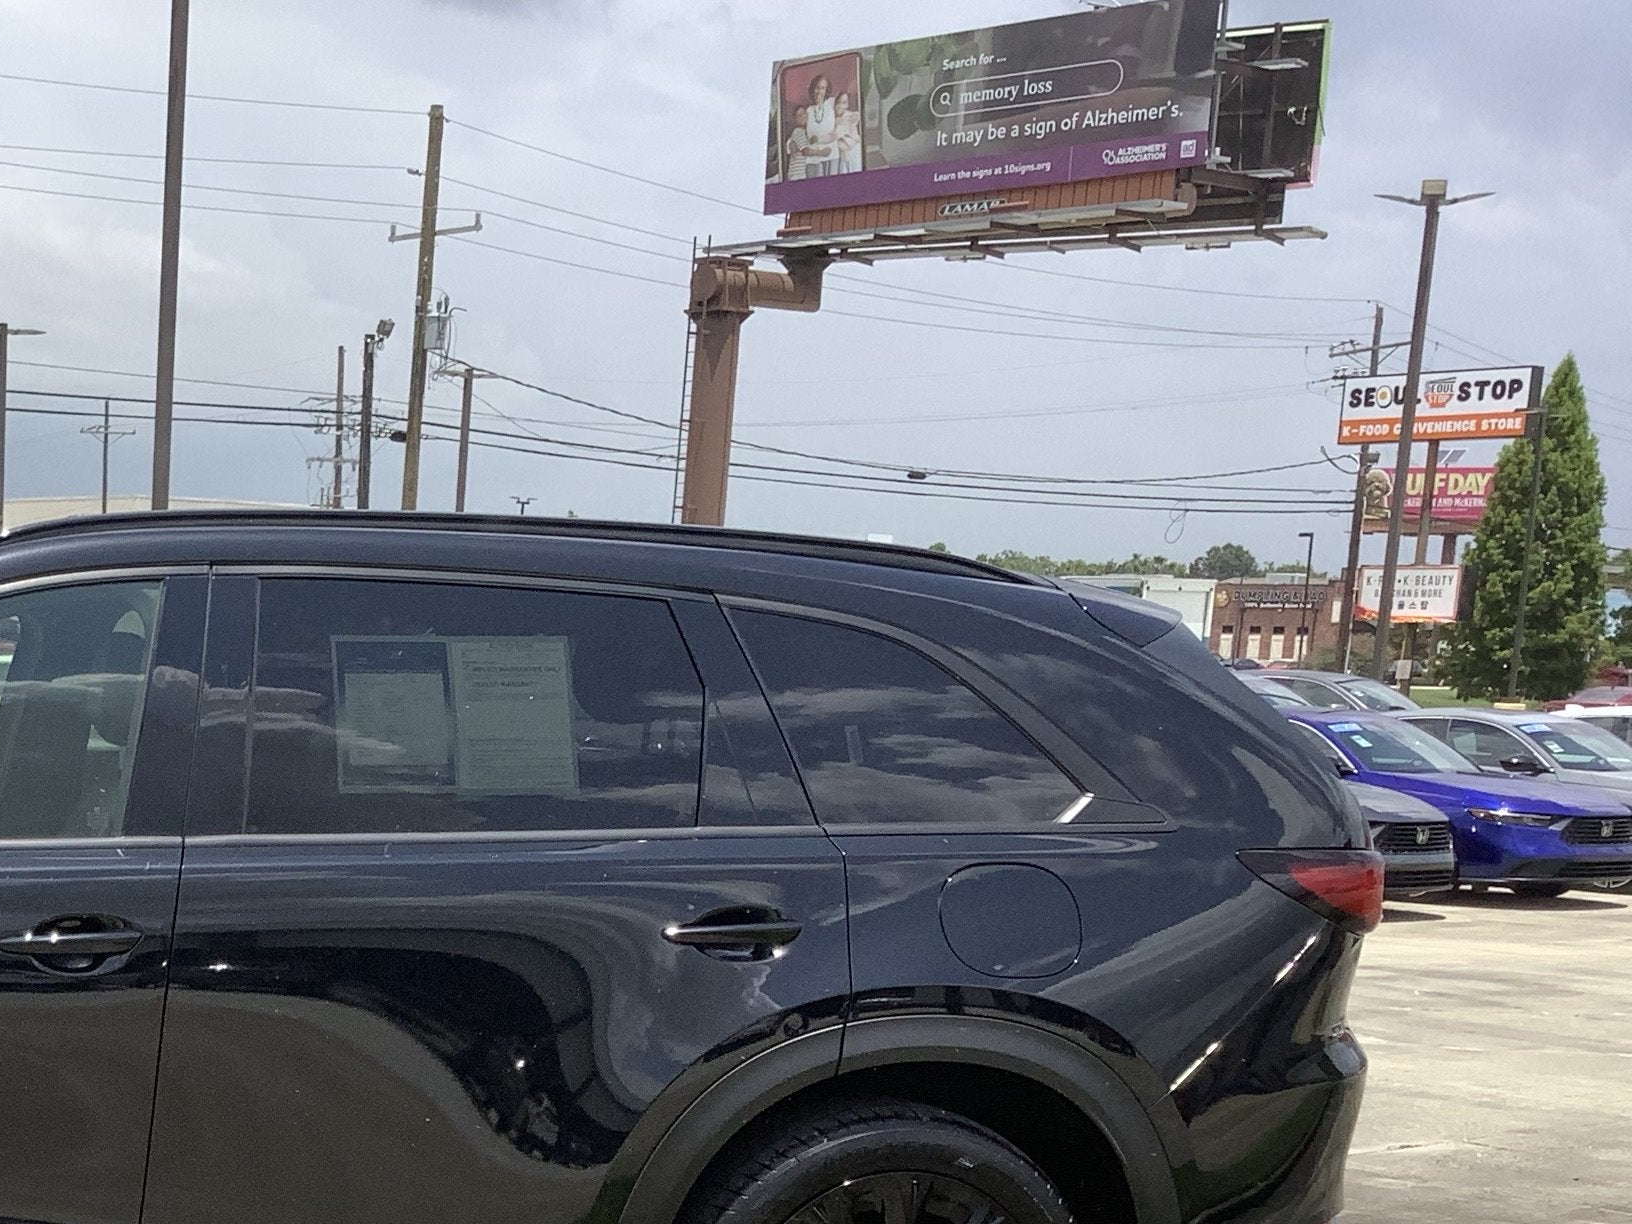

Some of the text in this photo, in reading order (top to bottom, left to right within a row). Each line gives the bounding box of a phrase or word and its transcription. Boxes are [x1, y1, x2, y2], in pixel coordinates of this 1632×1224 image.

[942, 55, 977, 71] Search
[978, 53, 995, 65] for
[959, 79, 1053, 104] memory loss
[936, 130, 948, 147] It
[952, 128, 984, 147] may
[988, 123, 1007, 140] be
[1010, 124, 1020, 137] a
[1023, 117, 1056, 139] sign
[1060, 111, 1081, 131] of
[1115, 151, 1167, 165] ASSOCIATION
[933, 161, 1052, 182] Learn the signs at 10signs.org
[1348, 378, 1524, 409] SEOU STOP
[1342, 416, 1523, 437] K-FOOD CVENIENCE STORE
[1447, 472, 1494, 496] DAY
[1420, 588, 1444, 598] MORE
